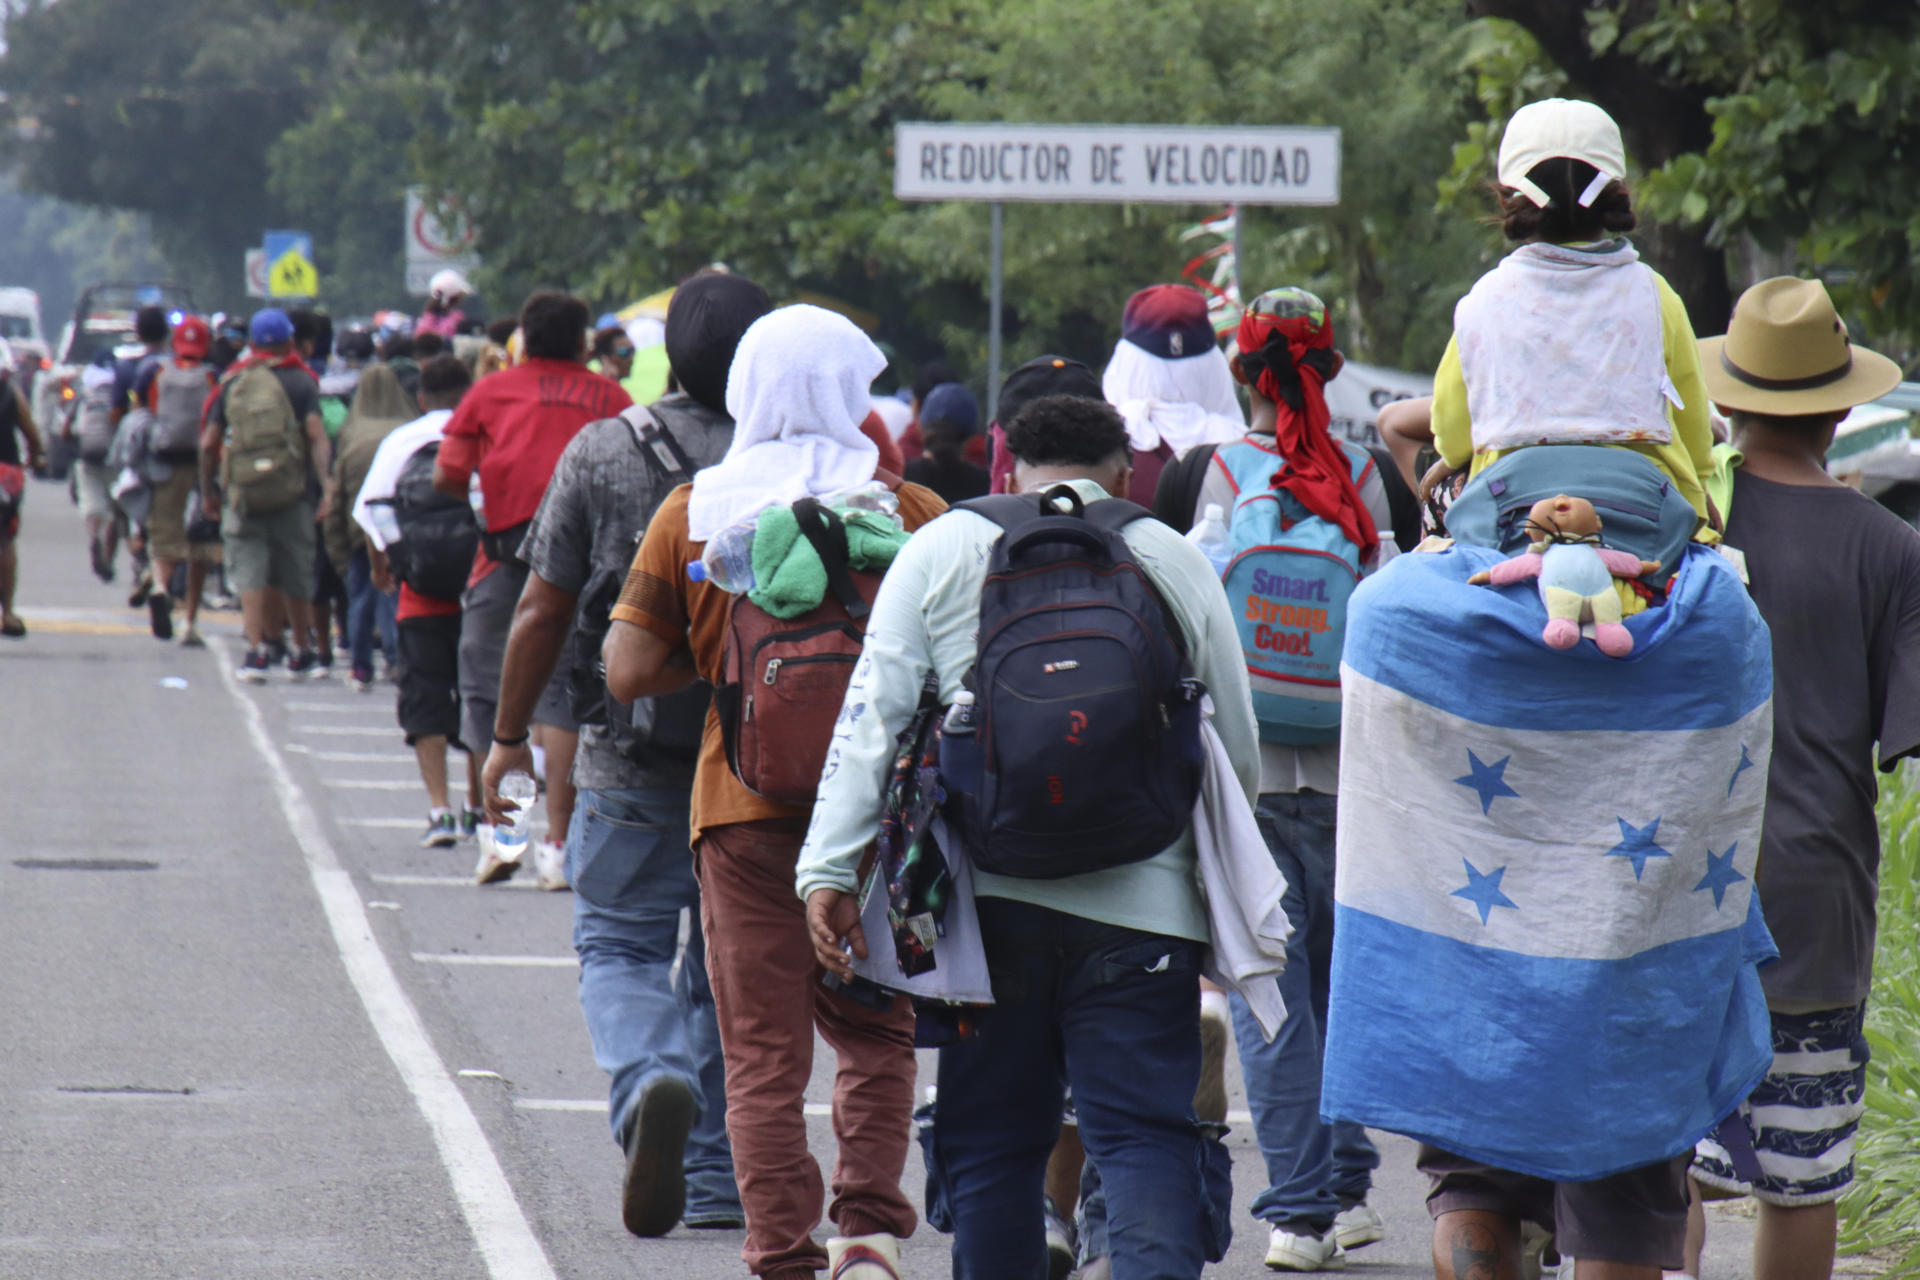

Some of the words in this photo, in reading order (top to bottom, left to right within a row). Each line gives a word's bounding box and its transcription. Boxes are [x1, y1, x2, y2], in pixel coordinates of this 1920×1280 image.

[920, 142, 1071, 182] REDUCTOR
[1090, 144, 1124, 184] DE
[1145, 144, 1311, 186] VELOCIDAD
[1252, 568, 1330, 602] Smart.
[1245, 594, 1331, 634] Strong.
[1255, 624, 1314, 656] Cool.
